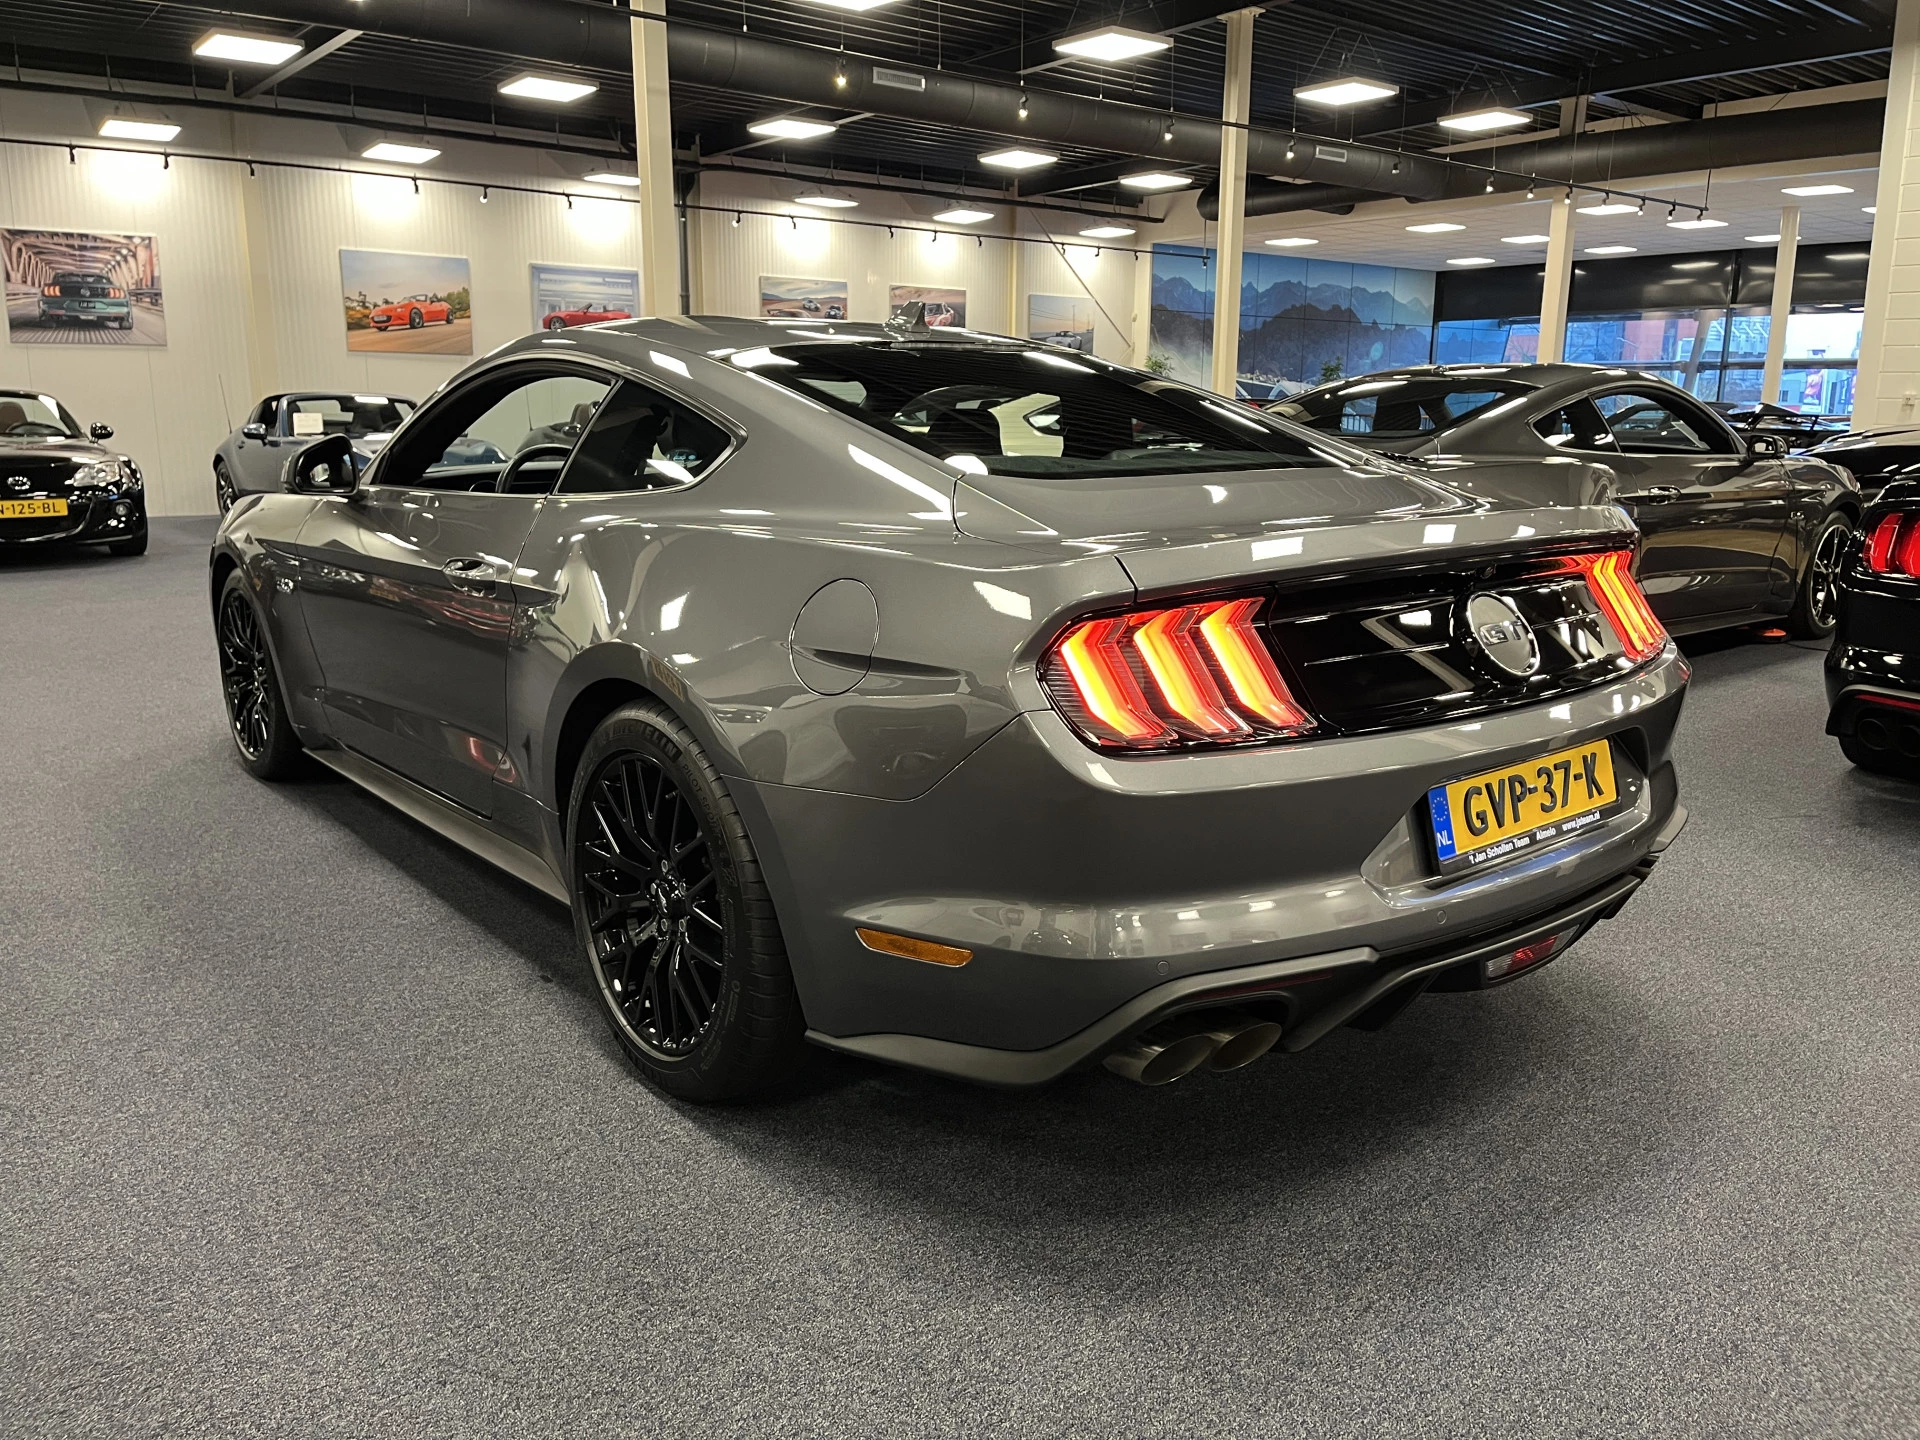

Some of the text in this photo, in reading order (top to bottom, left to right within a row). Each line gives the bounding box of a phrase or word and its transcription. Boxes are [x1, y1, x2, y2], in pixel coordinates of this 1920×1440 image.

[1480, 620, 1522, 646] GT
[682, 763, 703, 793] PILOT
[1463, 752, 1605, 836] GVP-37-K
[1437, 832, 1452, 847] NL
[1475, 851, 1487, 863] Jan
[1487, 842, 1514, 858] Scholten
[1513, 836, 1530, 849] Team
[1536, 827, 1557, 840] Almelo
